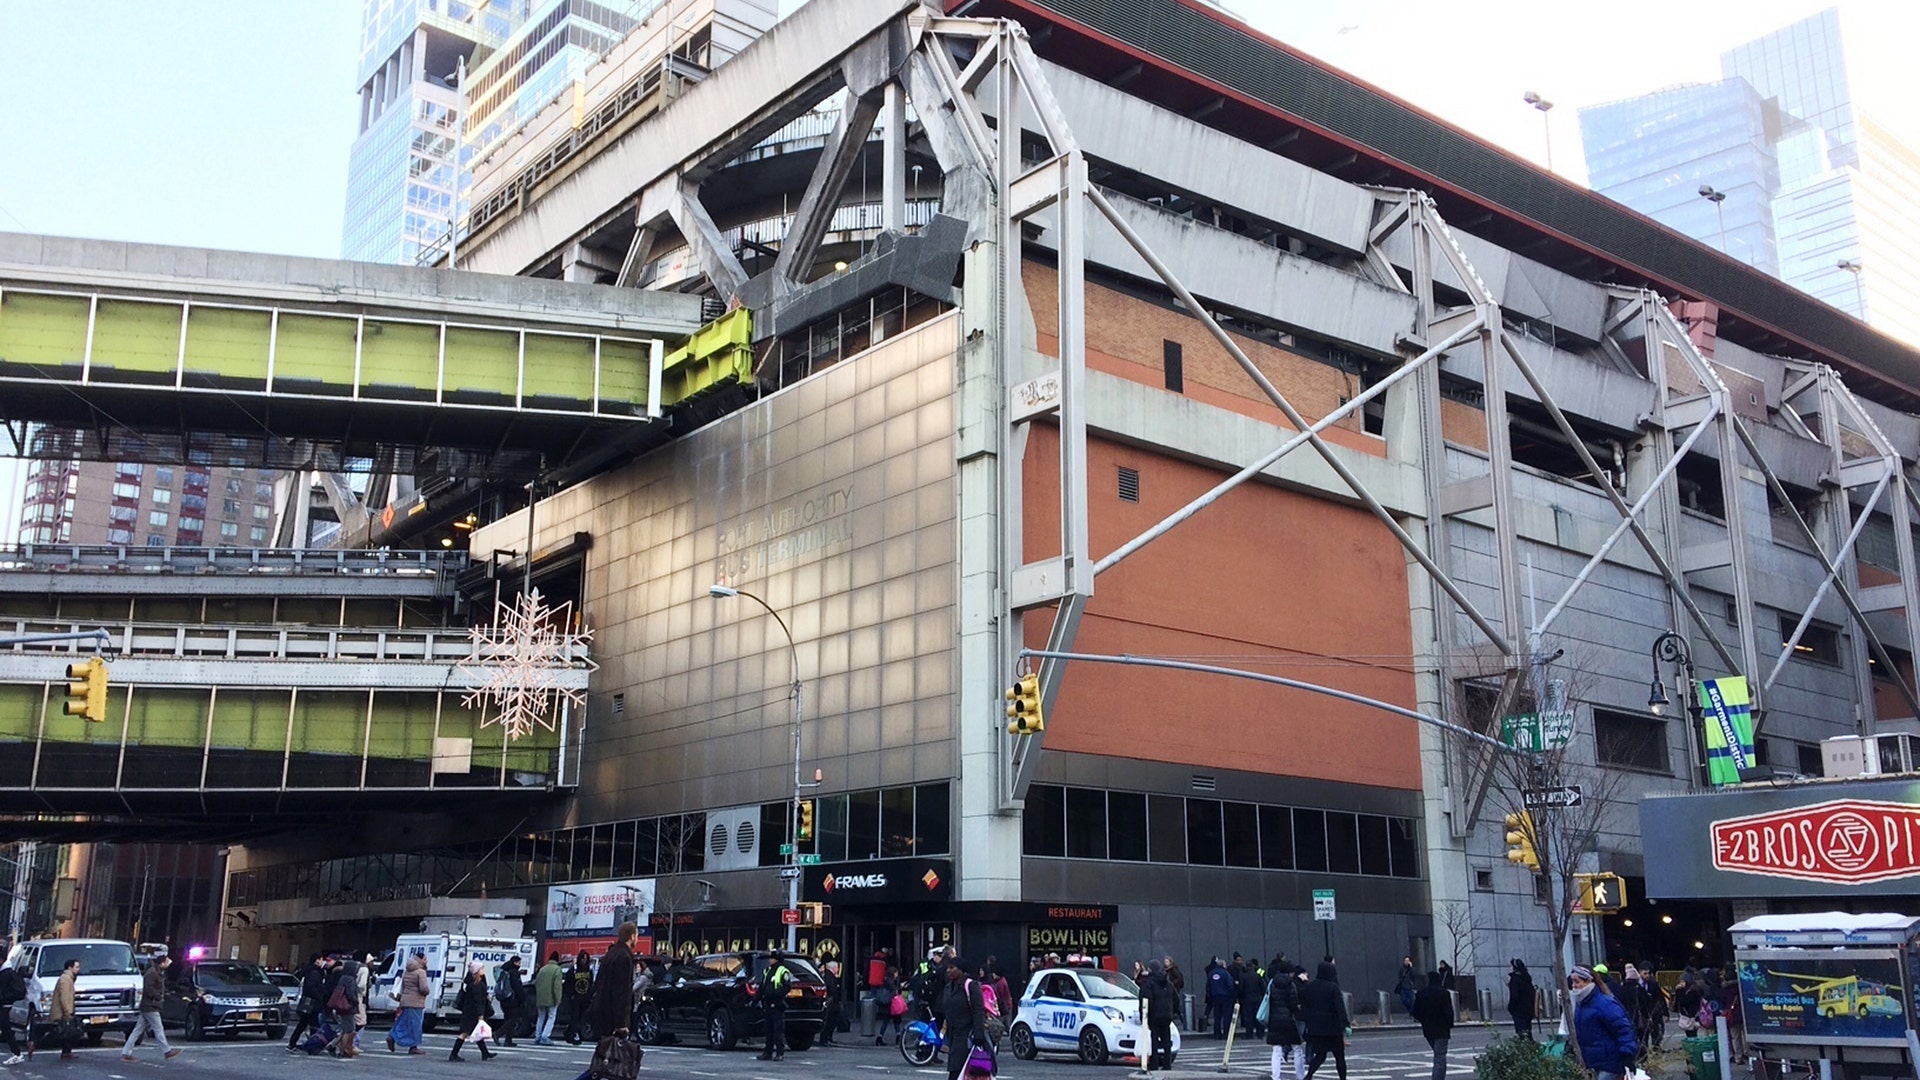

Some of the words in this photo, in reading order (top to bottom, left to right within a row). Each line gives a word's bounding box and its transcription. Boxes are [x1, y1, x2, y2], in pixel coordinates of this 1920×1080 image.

[717, 522, 754, 557] PORT
[762, 485, 853, 537] AUTHORITY
[718, 553, 750, 584] BUS
[758, 518, 853, 568] TERMINAL
[1709, 687, 1746, 770] #GarmentDistric
[1883, 815, 1920, 867] PI
[835, 874, 886, 889] FRAMES
[584, 895, 615, 905] EXCLUSIVE
[583, 905, 601, 915] SPACE
[602, 904, 616, 914] FOR
[1049, 907, 1102, 918] RESTAURANT
[942, 928, 949, 941] B
[1030, 928, 1108, 946] BOWLING
[1766, 934, 1787, 942] Phone
[472, 952, 506, 962] POLICE
[1775, 995, 1800, 1005] School
[1052, 1010, 1076, 1030] NYPD
